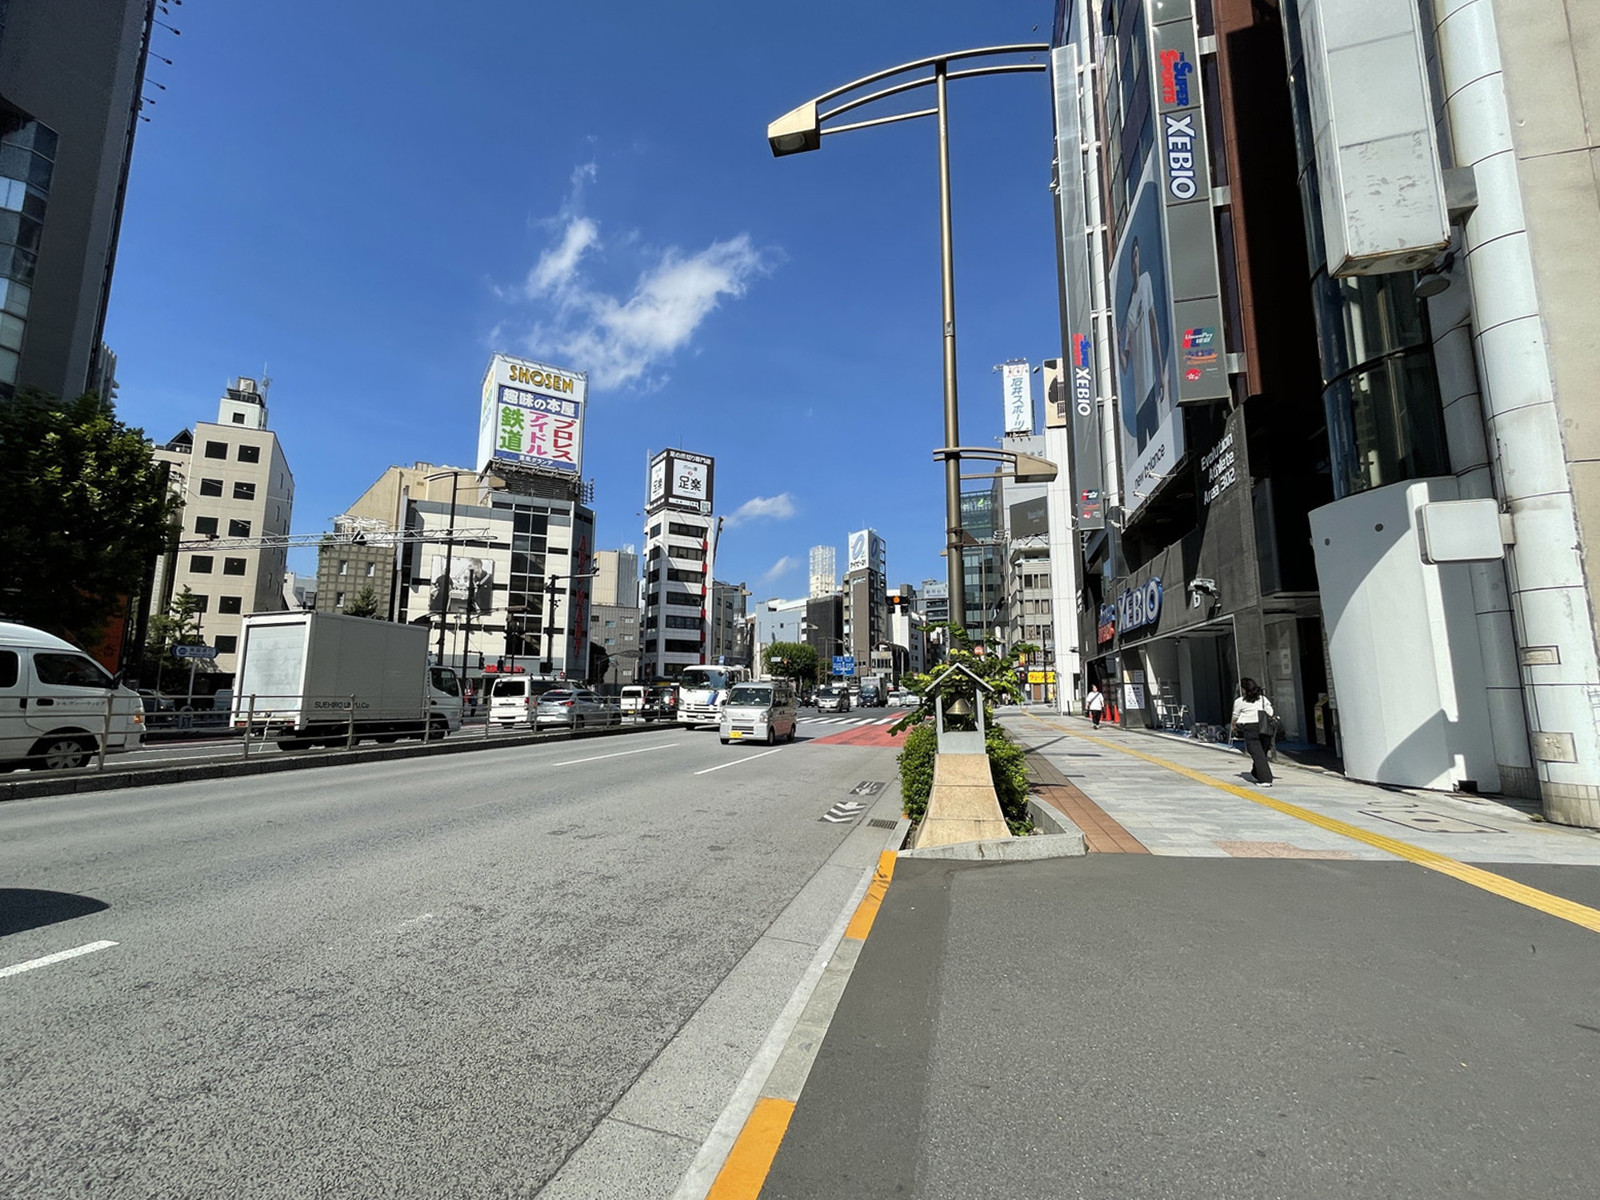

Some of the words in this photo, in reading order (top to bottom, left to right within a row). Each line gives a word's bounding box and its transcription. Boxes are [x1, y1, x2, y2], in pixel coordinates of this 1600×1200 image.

[1165, 114, 1197, 200] XEBIO
[509, 364, 574, 394] SHOSEN
[1076, 368, 1091, 416] XEBIO
[502, 388, 576, 417] 趣味の本屋
[1010, 377, 1025, 432] 石井スポーツ
[500, 406, 524, 452] 鉄道
[526, 410, 549, 456] アイドル
[552, 419, 577, 461] プロレス
[1200, 432, 1233, 472] Evolution
[1208, 451, 1235, 483] Athlete
[678, 475, 701, 492] 足楽
[1203, 484, 1220, 506] Area
[1219, 467, 1236, 492] 302
[1117, 577, 1163, 635] XEBIO
[314, 701, 344, 709] SUEHIRO
